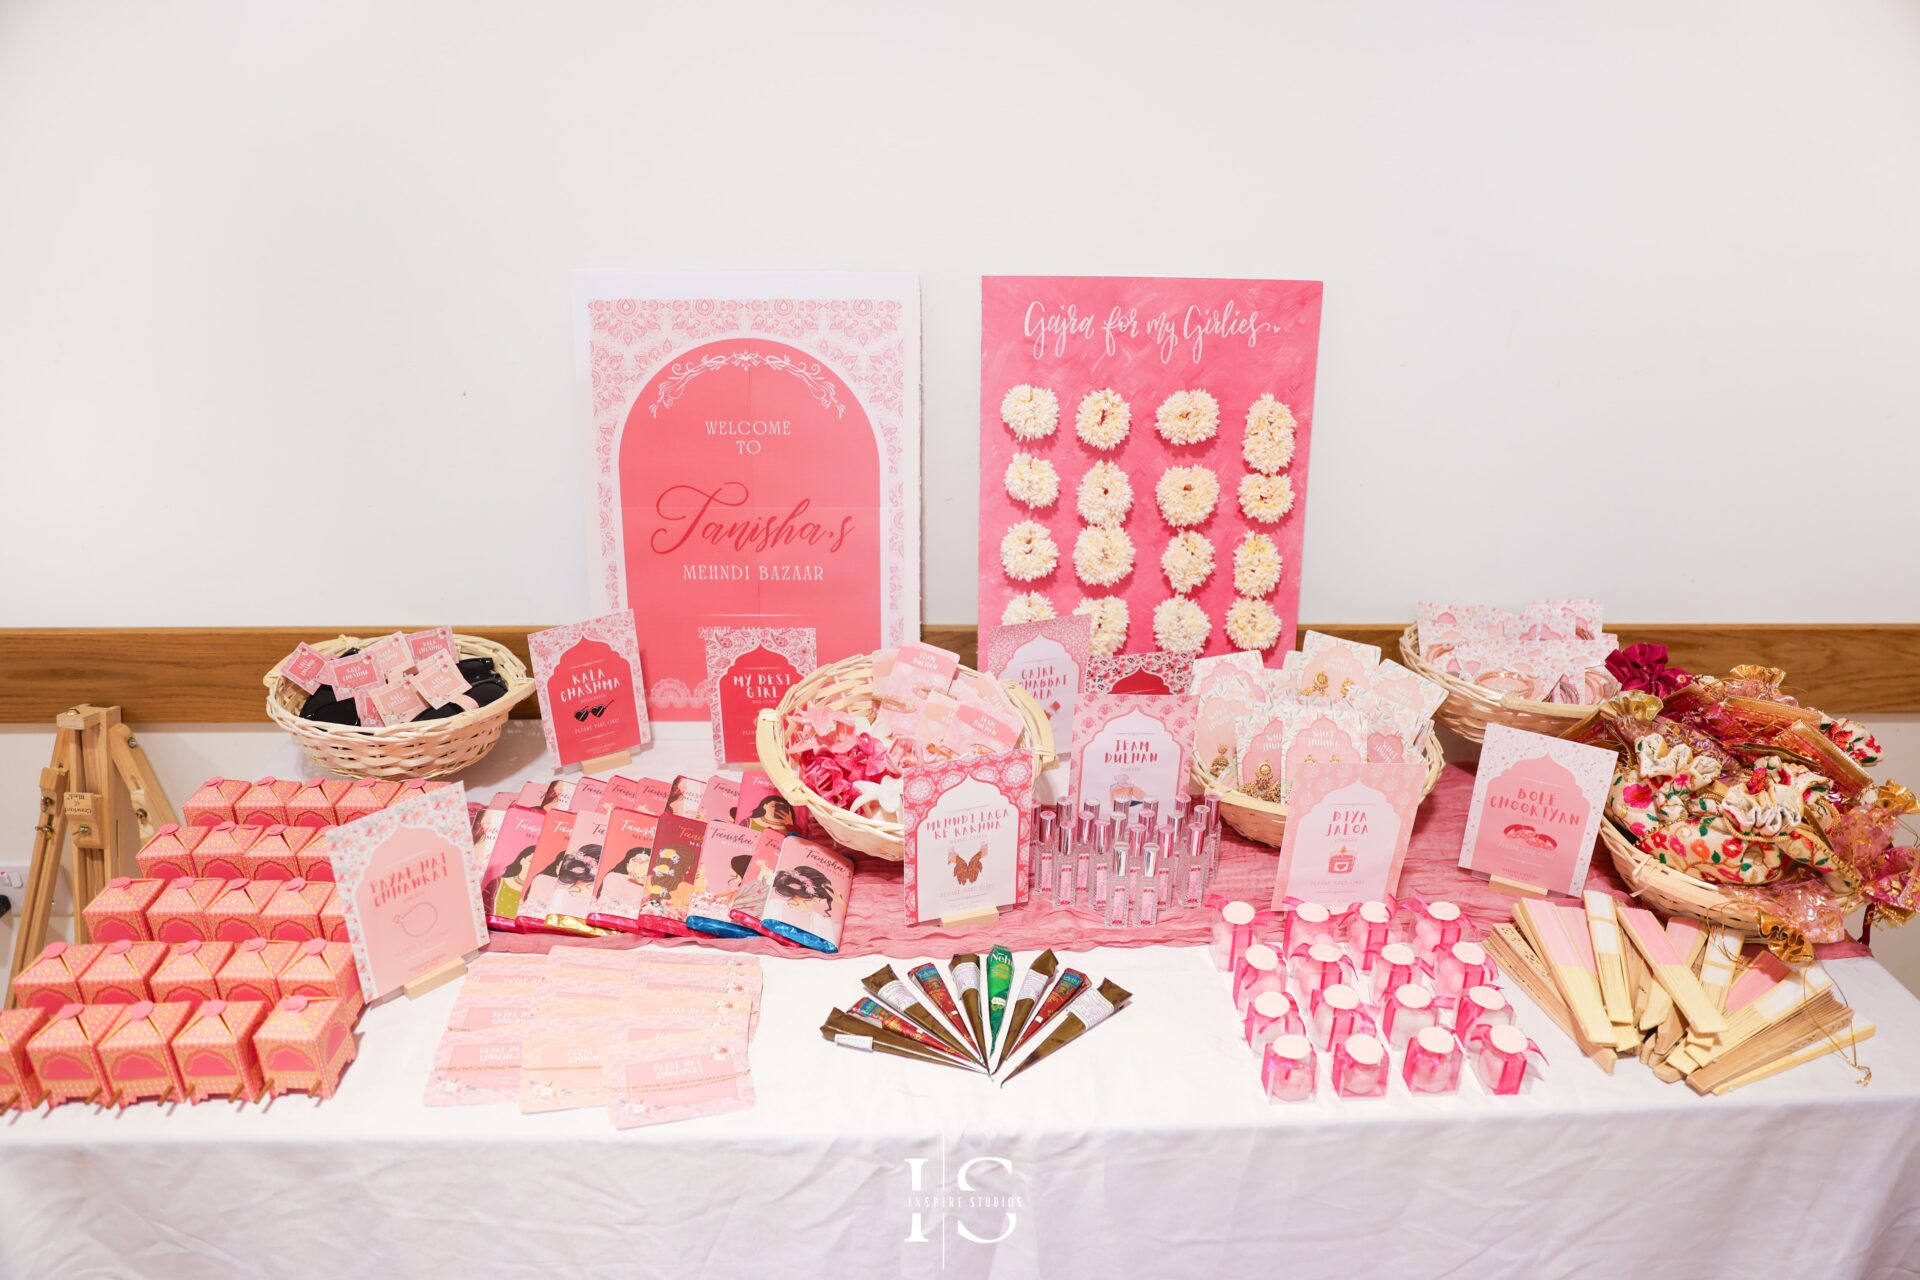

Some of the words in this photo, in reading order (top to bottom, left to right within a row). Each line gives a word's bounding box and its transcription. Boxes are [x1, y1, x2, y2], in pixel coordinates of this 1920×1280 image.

[1101, 305, 1139, 357] for
[1146, 311, 1179, 364] my
[705, 420, 792, 435] WELCOME
[736, 440, 761, 454] TO
[683, 565, 750, 581] MEHNDI
[759, 564, 824, 581] BAZAAR
[571, 668, 605, 685] KALA
[733, 673, 752, 688] MY
[758, 673, 791, 686] DESI
[560, 678, 622, 703] CHASHMA
[746, 685, 779, 699] GIRL
[1116, 739, 1150, 752] TEAM
[1104, 752, 1158, 764] DULHAN
[1518, 787, 1560, 806] BOLE
[1332, 810, 1368, 823] DIYA
[1489, 795, 1580, 825] CHOORIYAN
[926, 812, 975, 832] MEHNDI
[980, 808, 1009, 822] LAGA
[934, 829, 948, 841] KE
[370, 866, 411, 894] PAYAL
[420, 852, 446, 873] HAI
